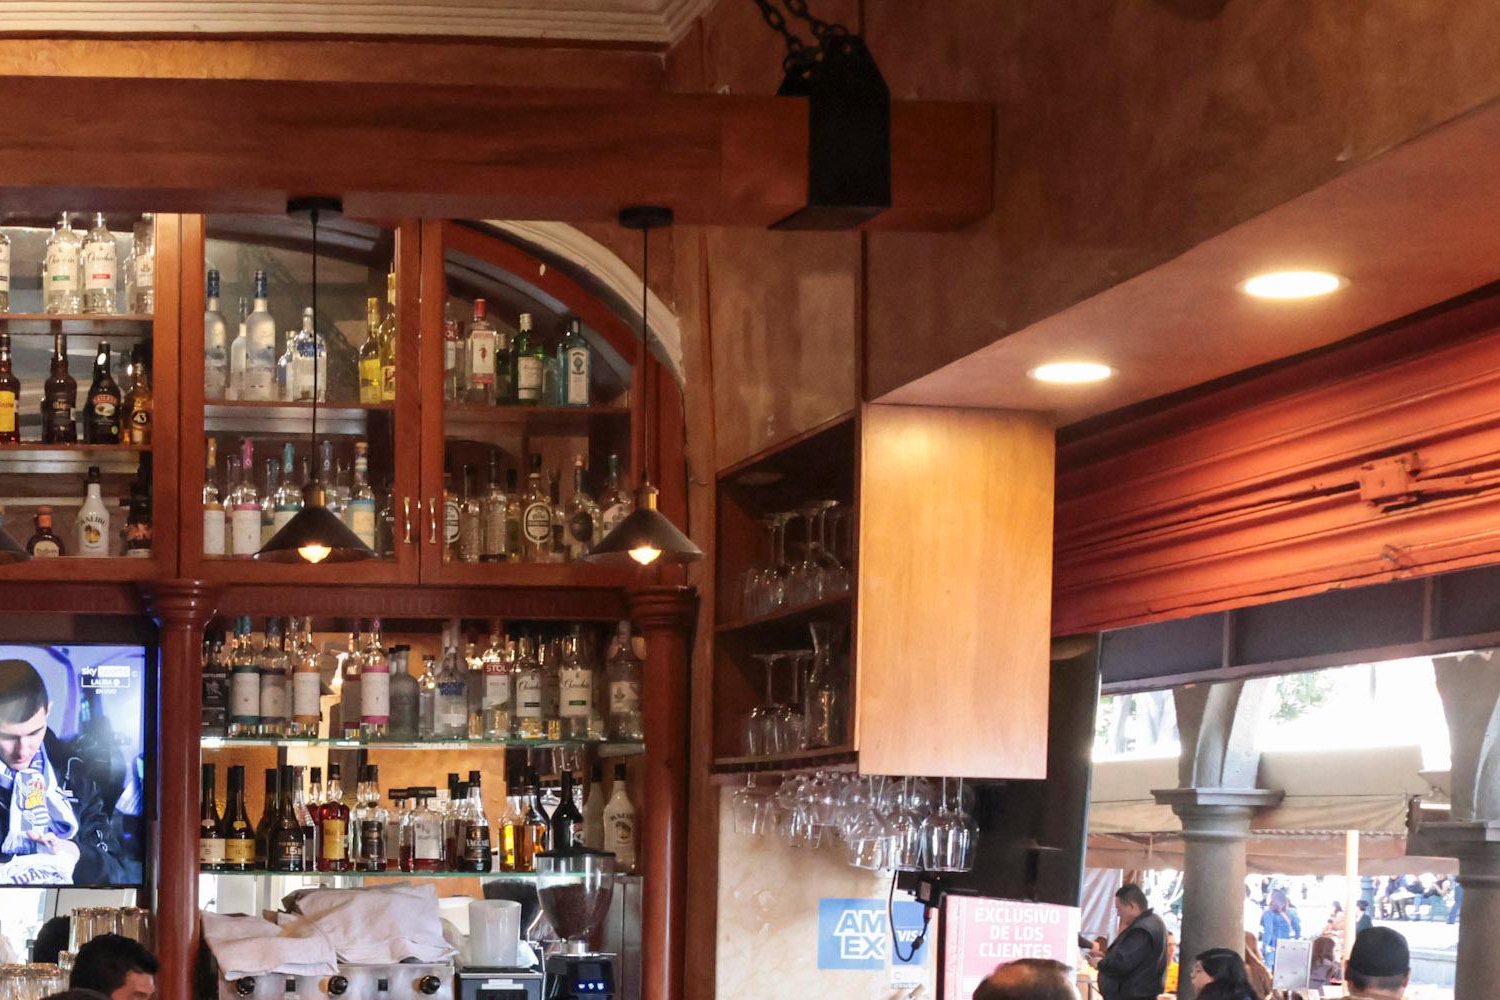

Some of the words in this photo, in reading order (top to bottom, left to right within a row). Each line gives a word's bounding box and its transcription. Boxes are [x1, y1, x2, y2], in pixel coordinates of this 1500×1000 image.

[81, 666, 97, 677] sky
[833, 909, 886, 937] AM
[974, 906, 1061, 924] EXCLUSIVO
[989, 924, 1011, 940] DE
[1014, 925, 1044, 941] LOS
[840, 934, 886, 960] EX
[979, 942, 1053, 959] CLIENTES
